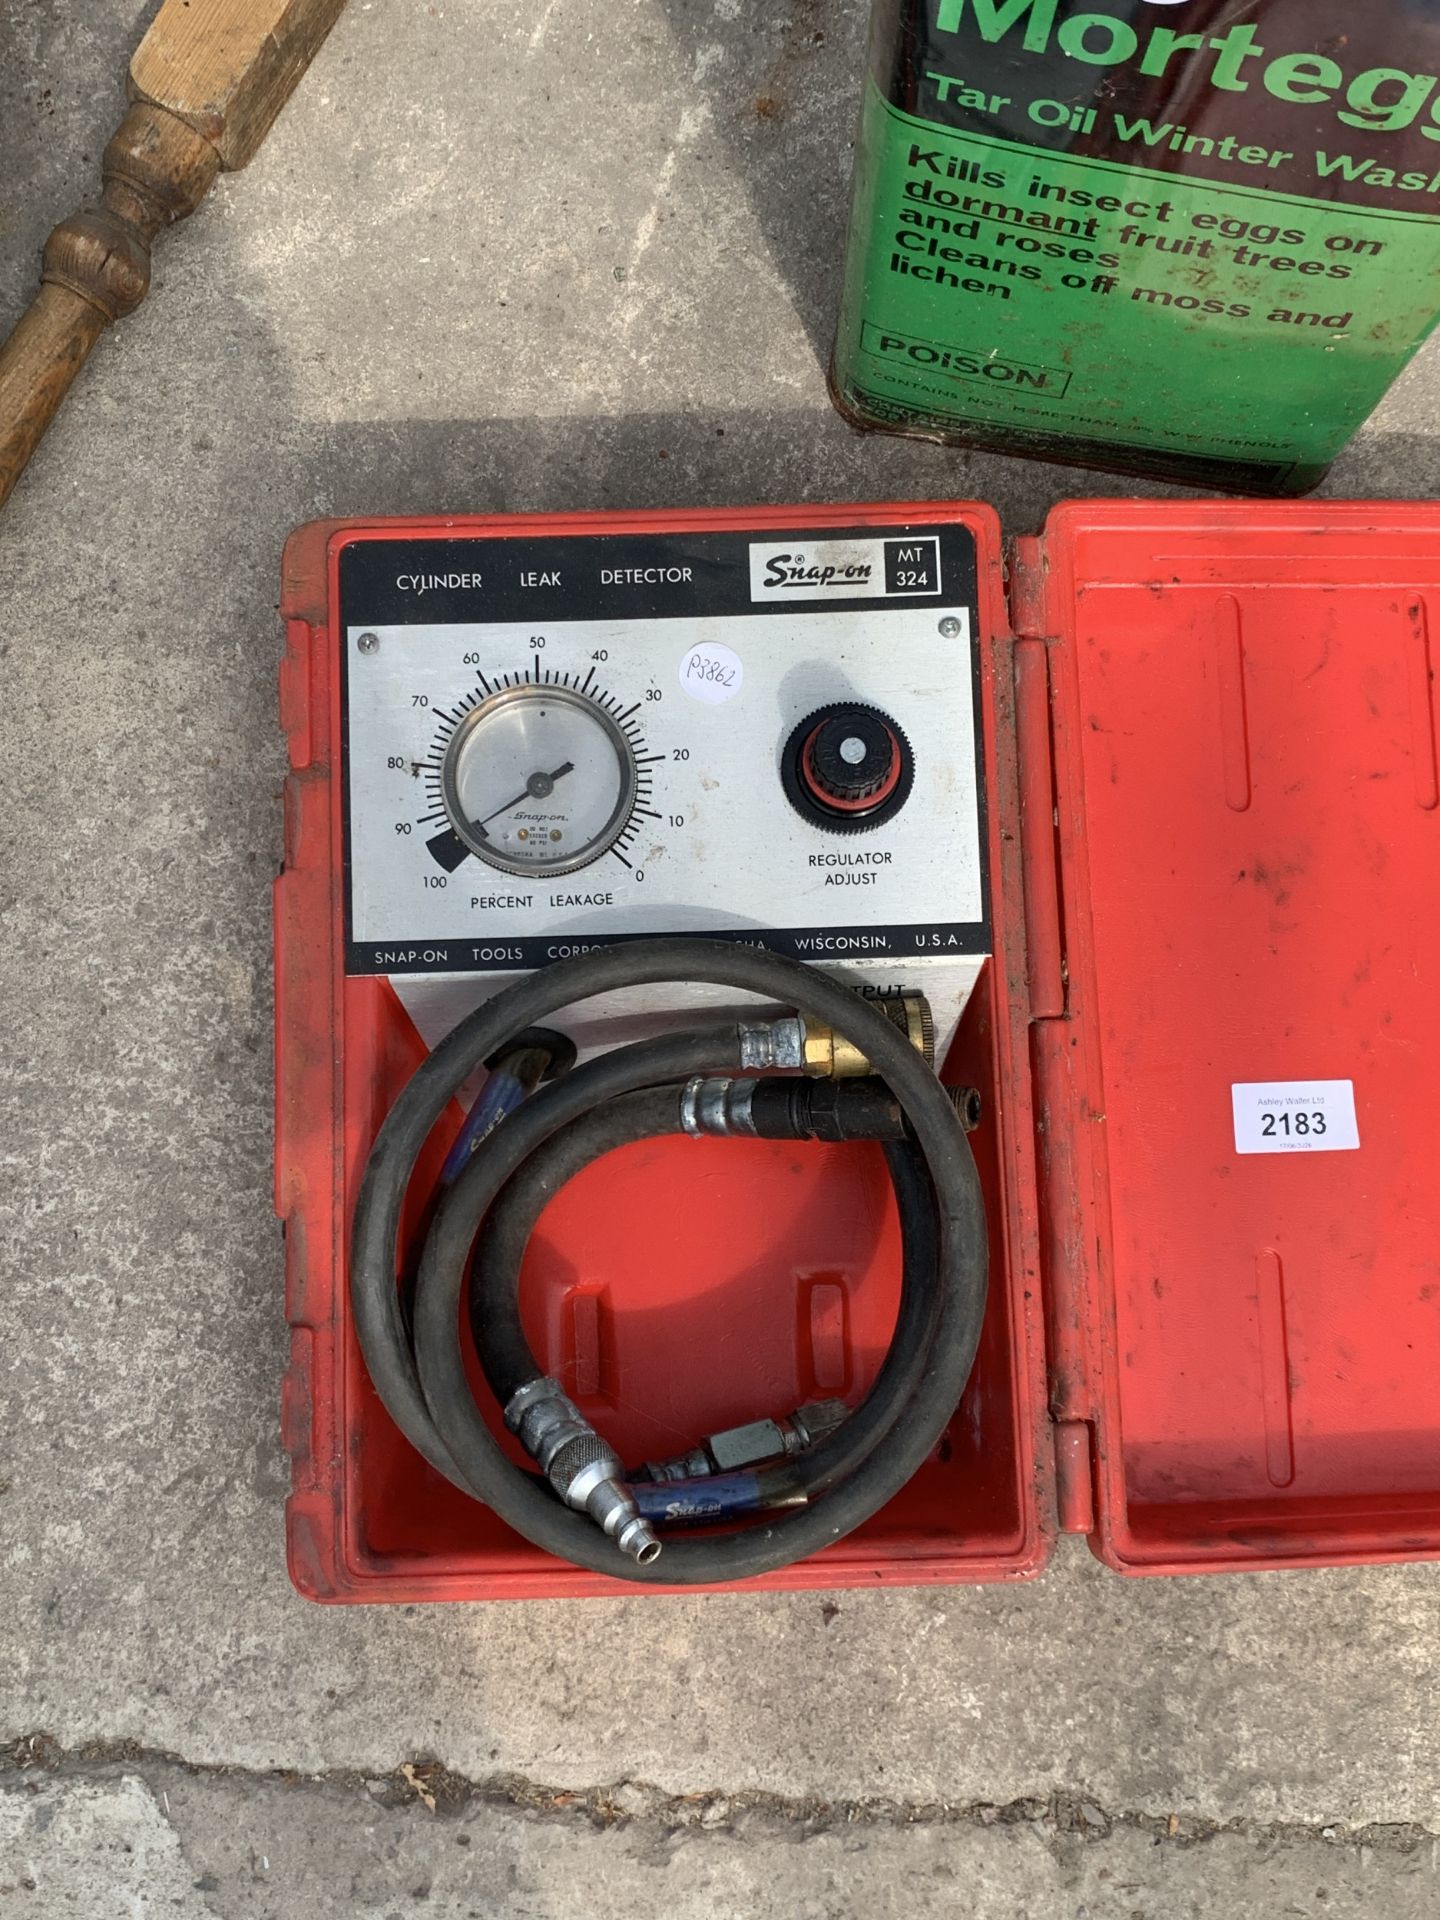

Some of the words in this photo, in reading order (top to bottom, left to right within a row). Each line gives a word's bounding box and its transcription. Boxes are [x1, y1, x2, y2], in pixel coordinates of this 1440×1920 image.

[925, 72, 1013, 114] Tar
[1028, 98, 1098, 135] Oil
[1114, 113, 1293, 168] Winter
[907, 144, 1006, 189] Kills
[1028, 175, 1174, 223] insect
[1191, 212, 1306, 246] eggs
[1324, 234, 1385, 257] on
[904, 178, 1101, 240] dormant
[1118, 225, 1214, 259] fruit
[1232, 246, 1353, 280] trees
[899, 206, 980, 241] and
[995, 231, 1120, 269] roses
[890, 252, 1012, 301] lichen
[895, 229, 1043, 280] Cleans
[1061, 271, 1121, 297] off
[1131, 286, 1251, 319] moss
[1266, 307, 1353, 330] and
[880, 336, 1048, 388] POISON
[873, 372, 958, 399] CONTAINS
[898, 548, 923, 562] MT
[763, 554, 872, 587] Snap-on
[396, 574, 482, 590] CYLINDER
[520, 572, 561, 587] LEAK
[601, 568, 692, 584] DETECTOR
[897, 571, 928, 586] 324
[530, 636, 546, 648] 50
[463, 652, 480, 664] 60
[592, 649, 609, 662] 40
[412, 695, 429, 707] 70
[645, 689, 662, 701] 30
[673, 748, 690, 761] 20
[387, 757, 404, 769] 80
[513, 811, 565, 822] Snap-on
[668, 815, 685, 827] 10
[395, 823, 411, 835] 90
[808, 852, 893, 867] REGULATOR
[423, 876, 447, 889] 100
[635, 869, 645, 882] 0
[825, 872, 877, 886] ADJUST
[470, 895, 533, 909] PERCENT
[550, 893, 613, 907] LEAKAGE
[374, 950, 449, 964] SNAP-ON
[472, 947, 523, 961] TOOLS
[795, 935, 892, 950] WISCONSIN,
[915, 934, 964, 947] U.S.A.
[850, 985, 906, 998] TPUT
[1261, 1112, 1327, 1136] 2183
